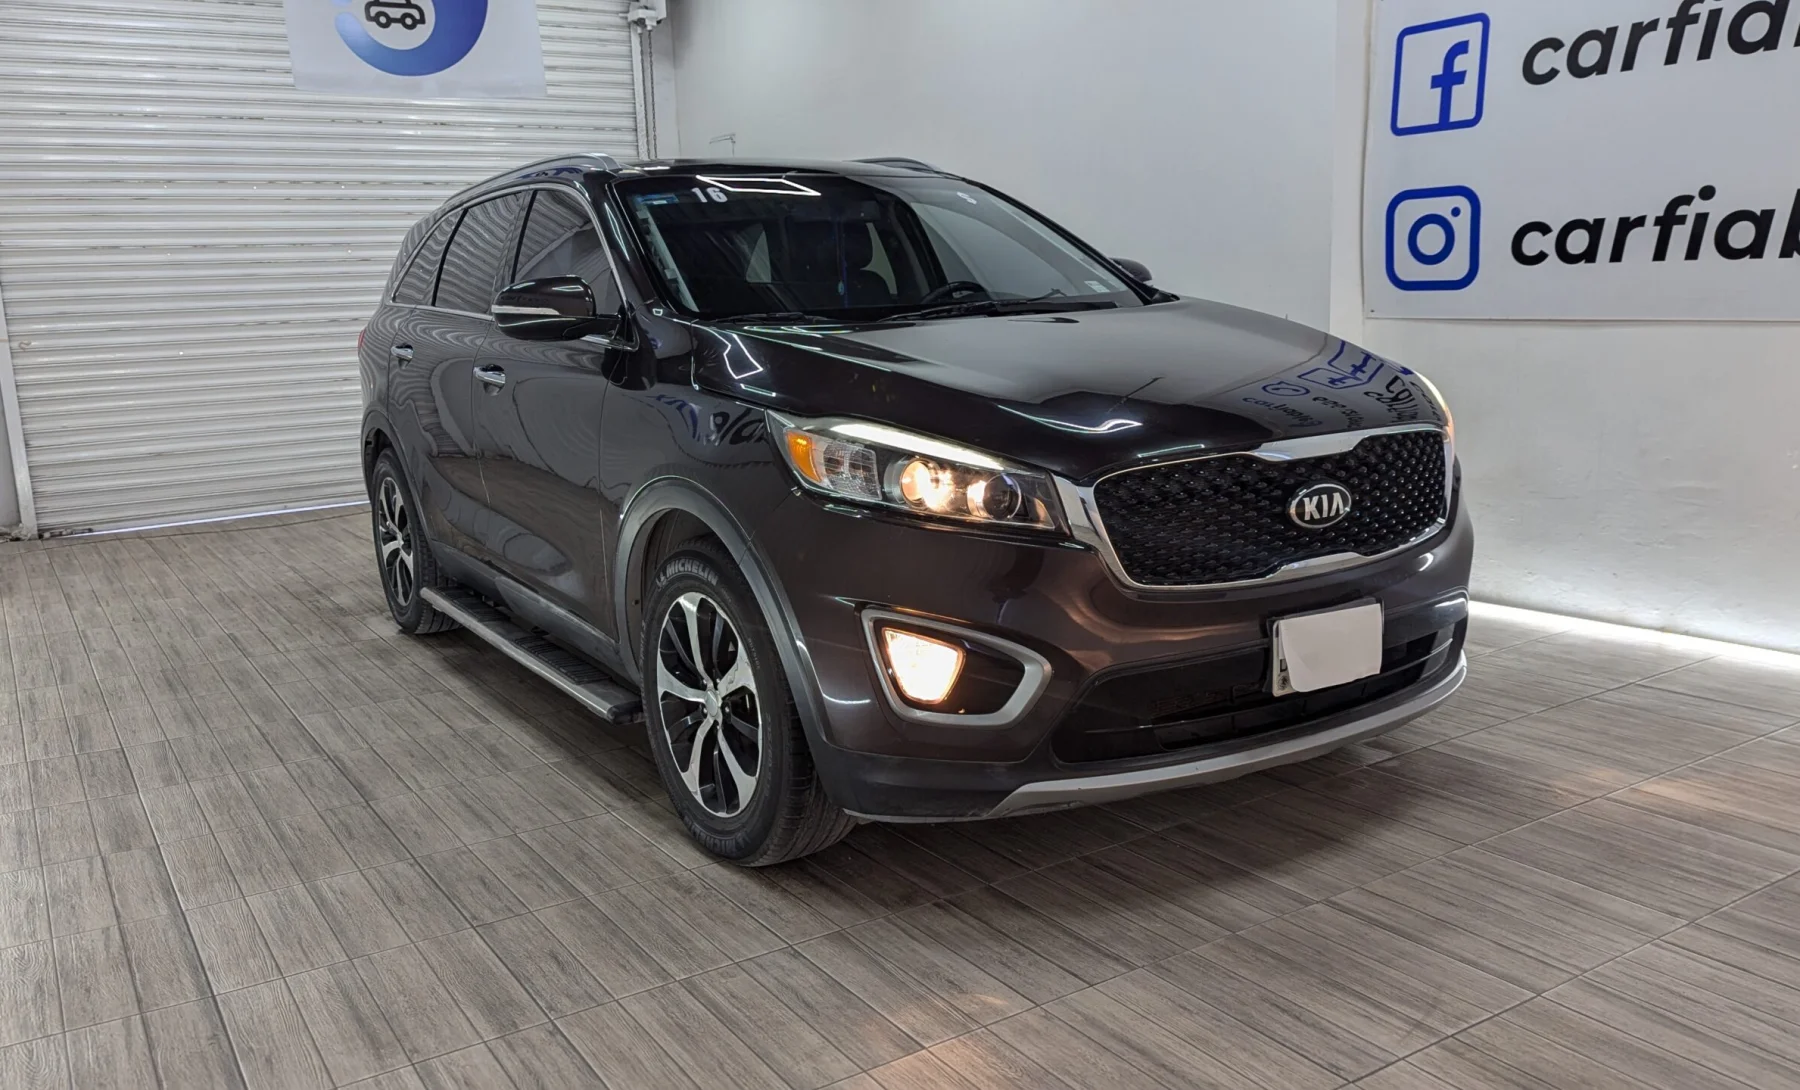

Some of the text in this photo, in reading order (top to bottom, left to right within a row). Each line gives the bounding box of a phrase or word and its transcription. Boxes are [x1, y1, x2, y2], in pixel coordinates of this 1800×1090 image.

[1522, 0, 1800, 86] carfia
[692, 187, 728, 203] 16
[1303, 492, 1344, 521] KIA
[666, 558, 719, 586] MICHELIN
